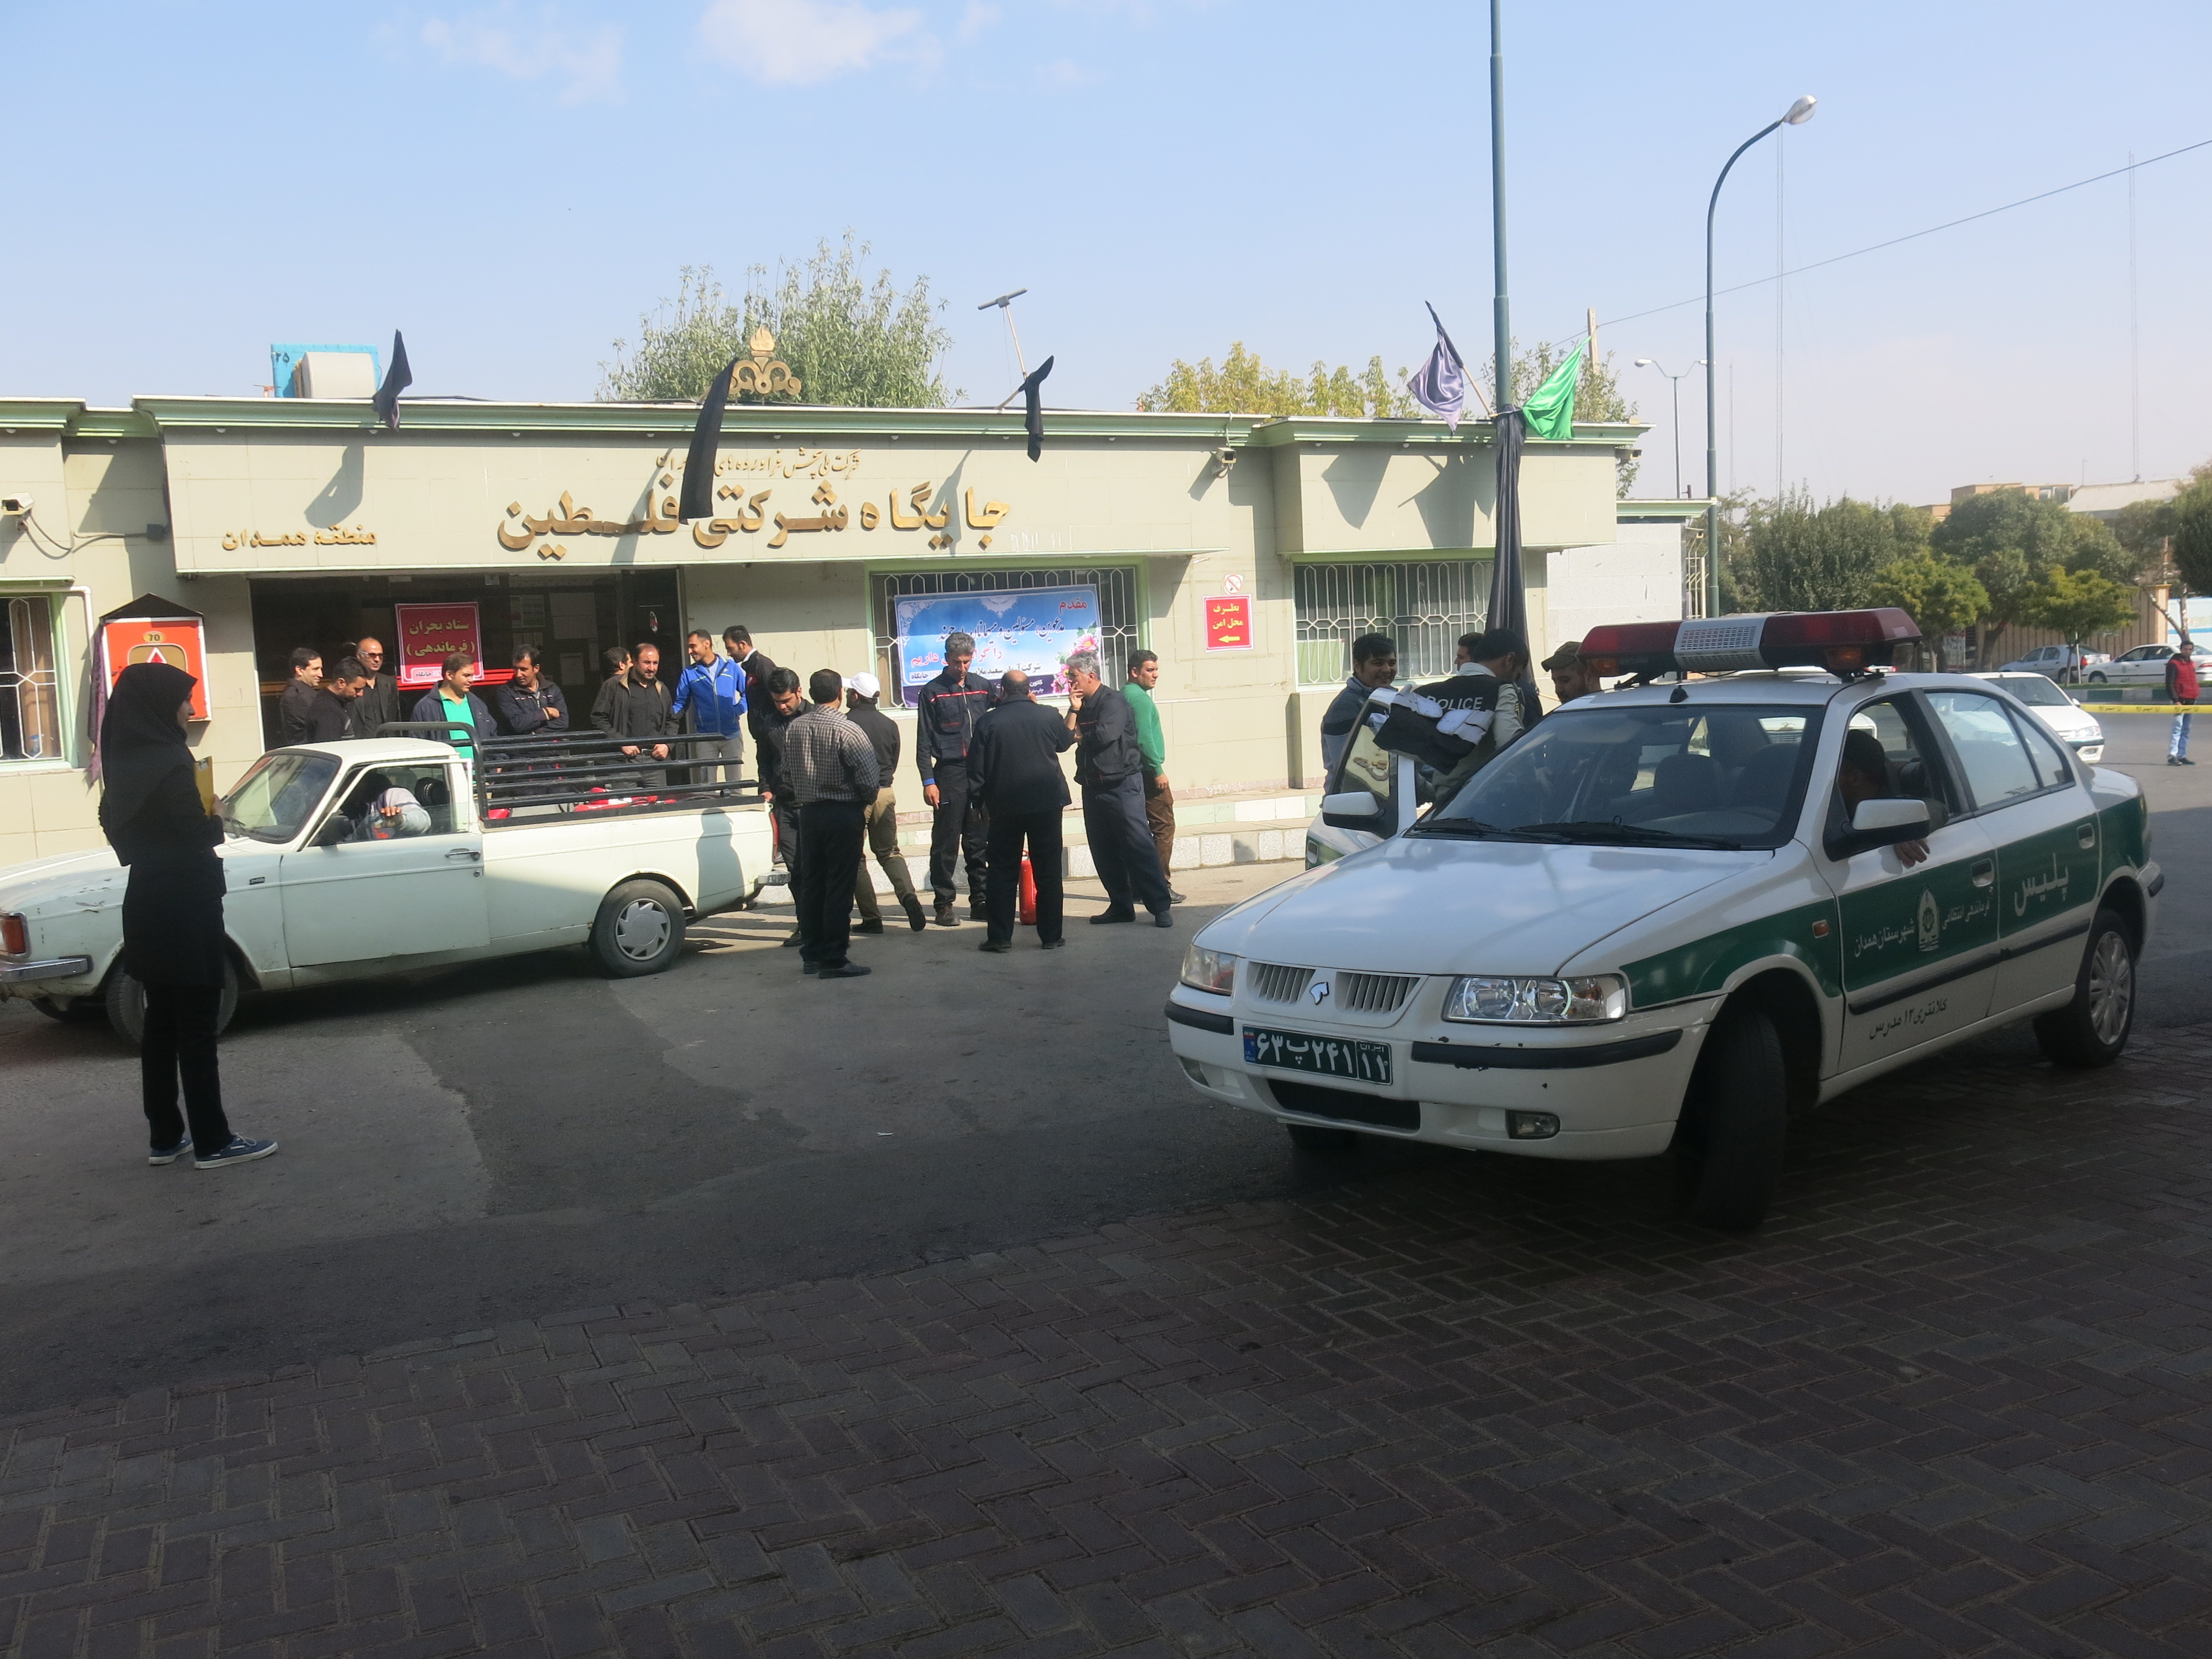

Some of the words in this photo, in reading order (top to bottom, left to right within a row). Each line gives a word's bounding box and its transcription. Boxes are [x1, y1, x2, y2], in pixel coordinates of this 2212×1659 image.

[783, 446, 823, 479] پخش
[832, 448, 861, 481] شرکت
[498, 472, 680, 560] فلسطین
[693, 479, 849, 547] شرکتی
[860, 481, 1010, 550] جایگاه
[222, 529, 307, 551] همدان
[314, 524, 376, 545] منطقه
[1059, 598, 1087, 615] مقدم
[1213, 602, 1240, 615] بطرف
[409, 620, 442, 635] بحران
[445, 619, 469, 630] ستاد
[1212, 618, 1225, 630] امن
[1227, 617, 1244, 629] محل
[911, 651, 939, 667] داریم
[1021, 662, 1041, 672] شرکت
[2014, 852, 2069, 917] پلیس
[1878, 918, 1914, 950] شهرستان
